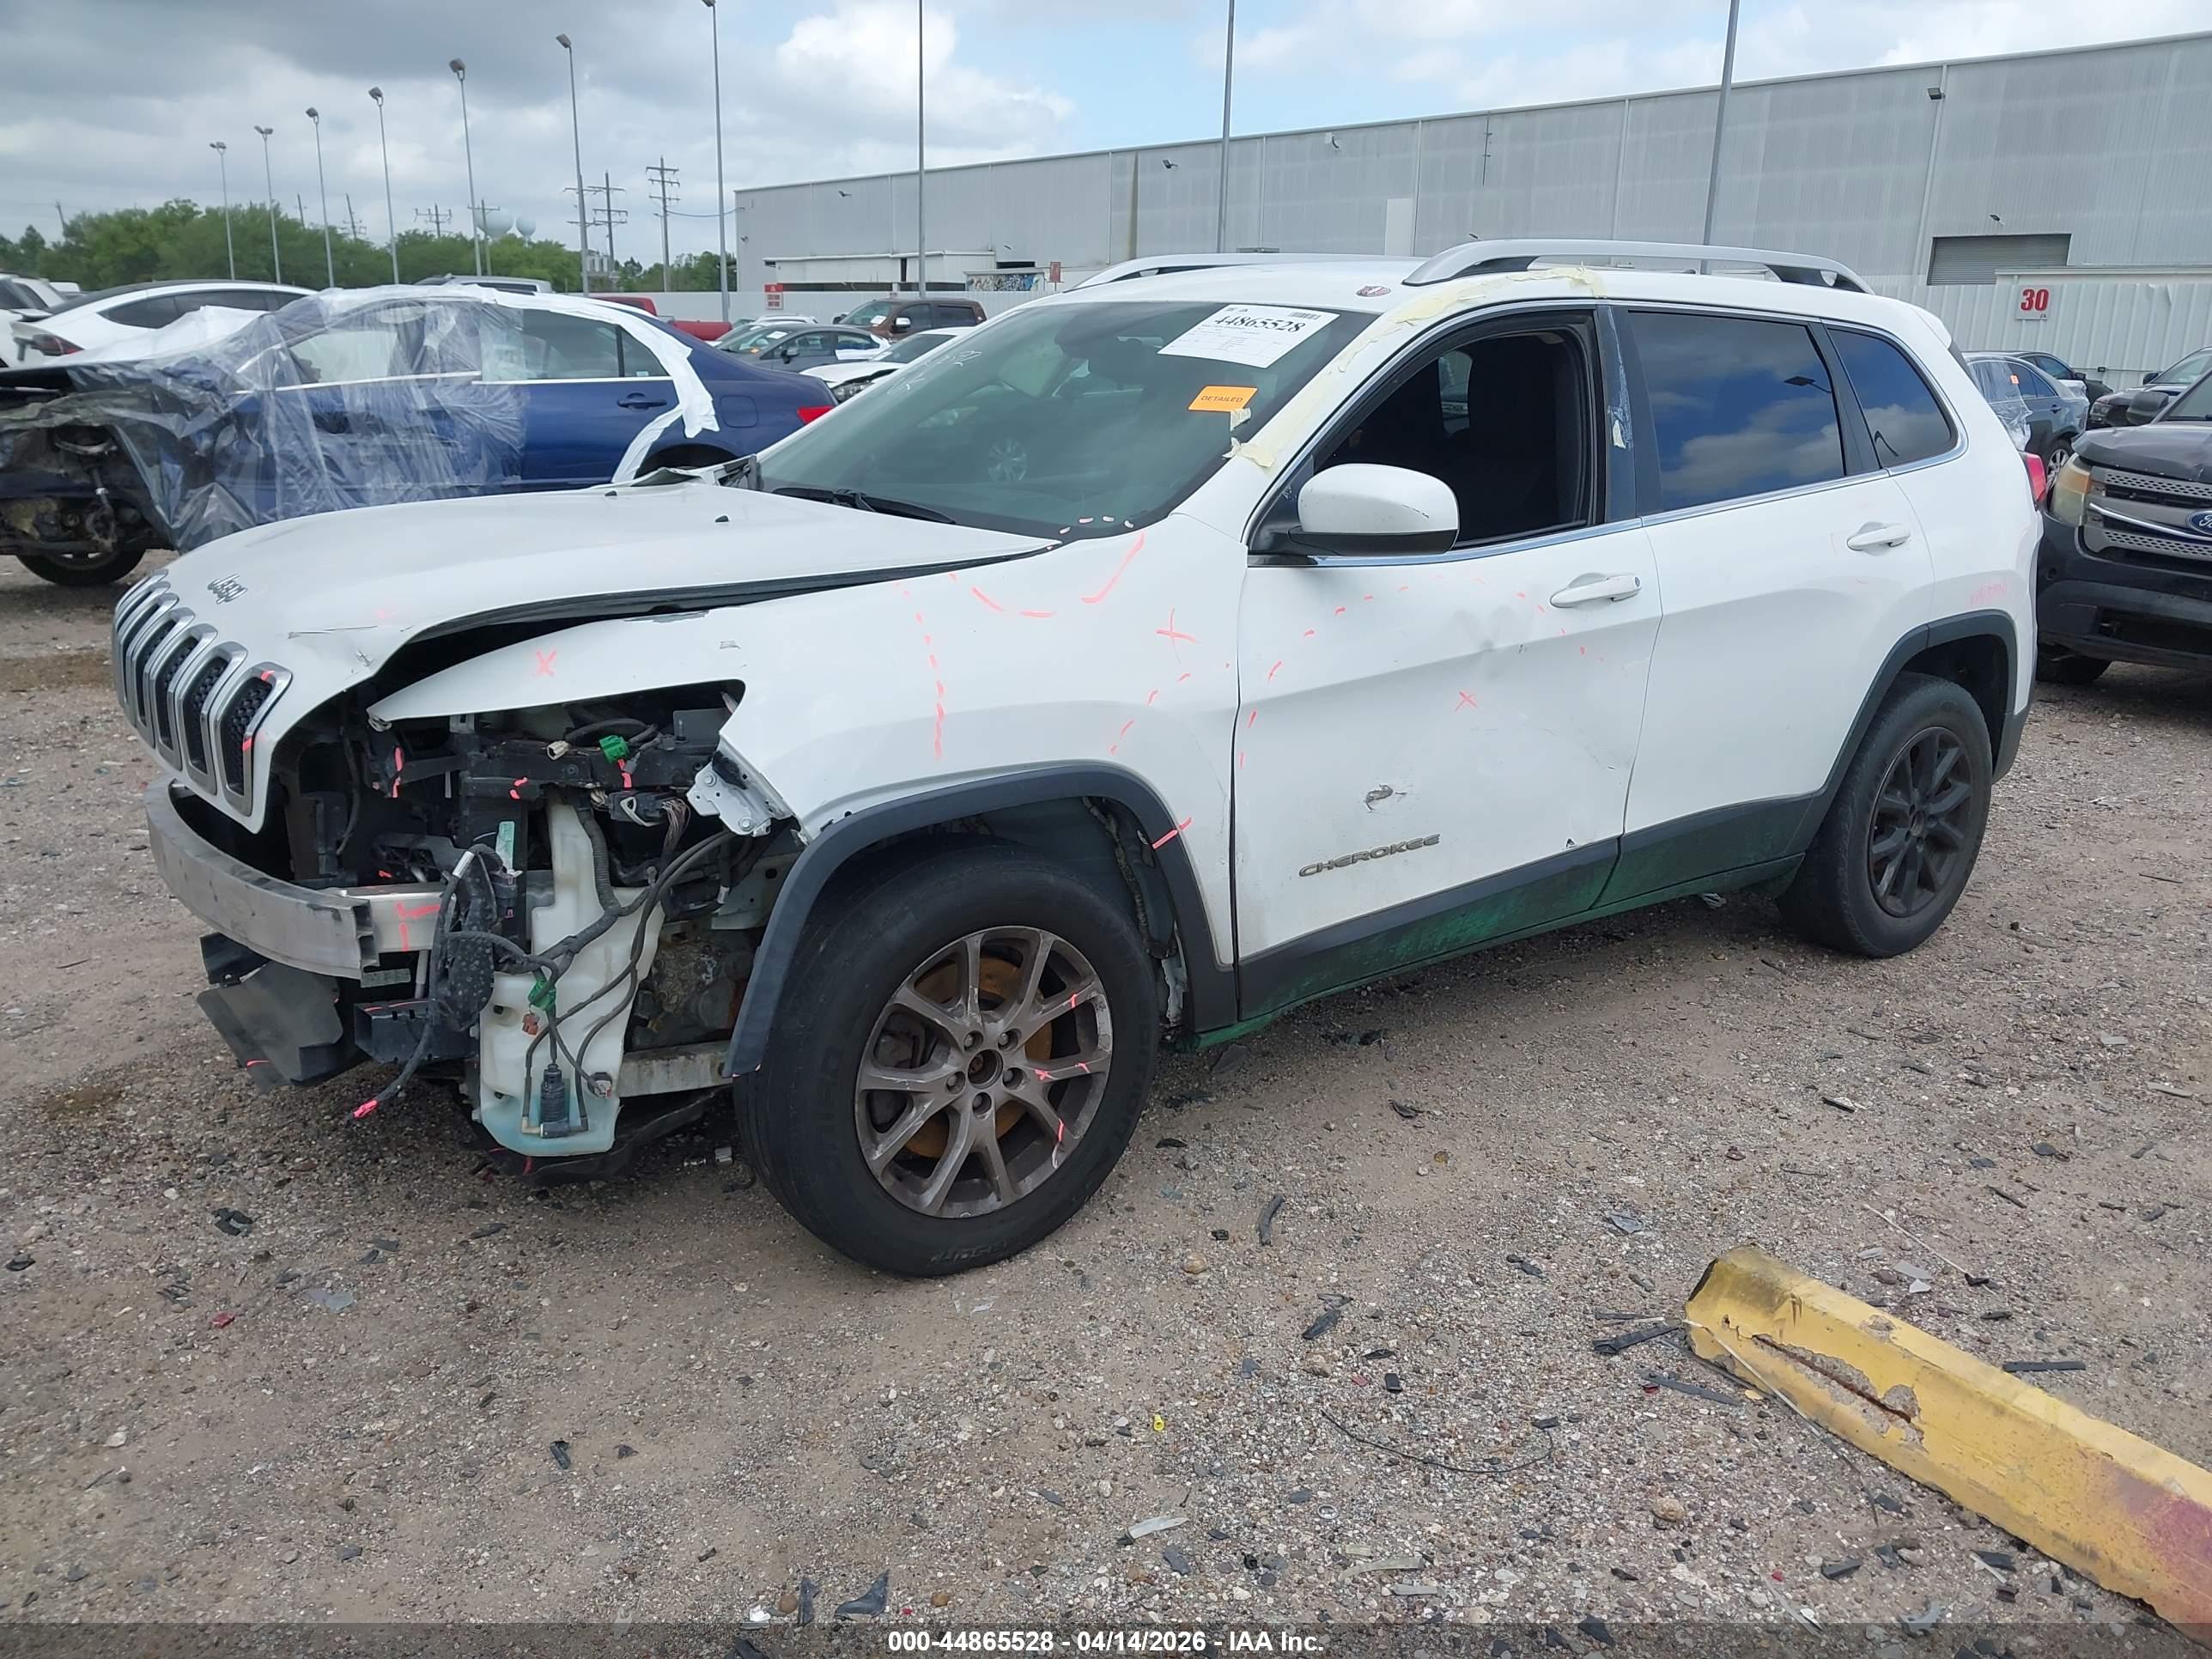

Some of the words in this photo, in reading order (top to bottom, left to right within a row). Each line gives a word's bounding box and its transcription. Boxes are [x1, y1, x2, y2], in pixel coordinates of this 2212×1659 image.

[2021, 289, 2049, 311] 30
[1214, 315, 1306, 332] 44865528
[207, 574, 248, 605] Jeep
[1298, 833, 1441, 878] CHEROKEE
